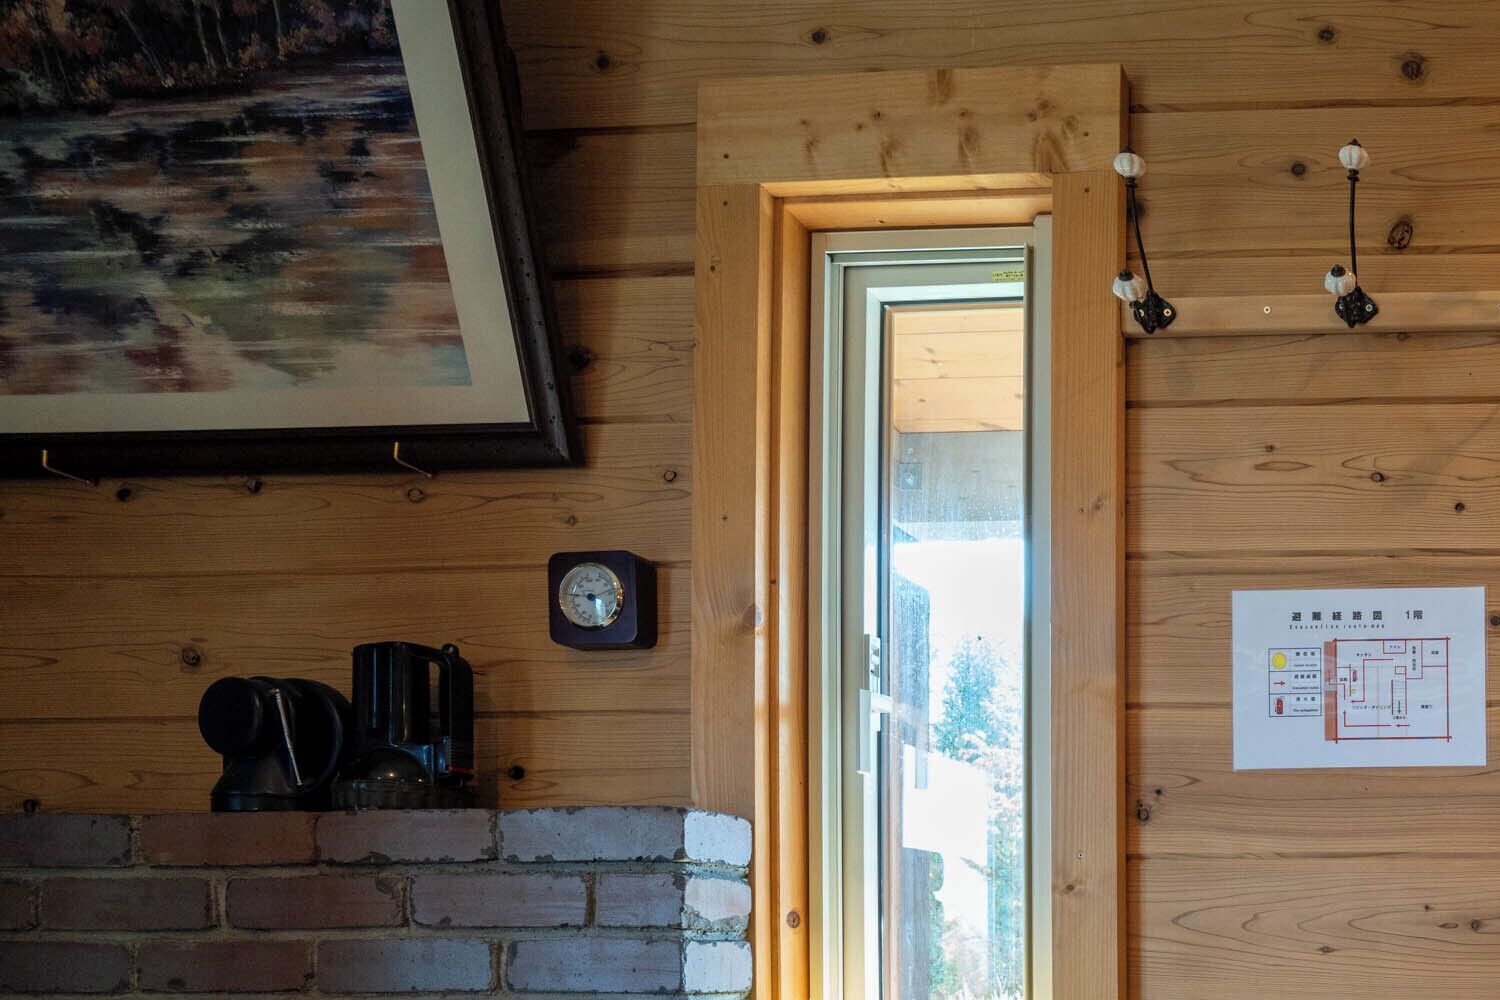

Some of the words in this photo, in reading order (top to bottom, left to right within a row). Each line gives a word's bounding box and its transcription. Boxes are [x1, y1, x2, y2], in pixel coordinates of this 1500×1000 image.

[1291, 610, 1383, 622] 避難経路図
[1405, 610, 1424, 620] 1階
